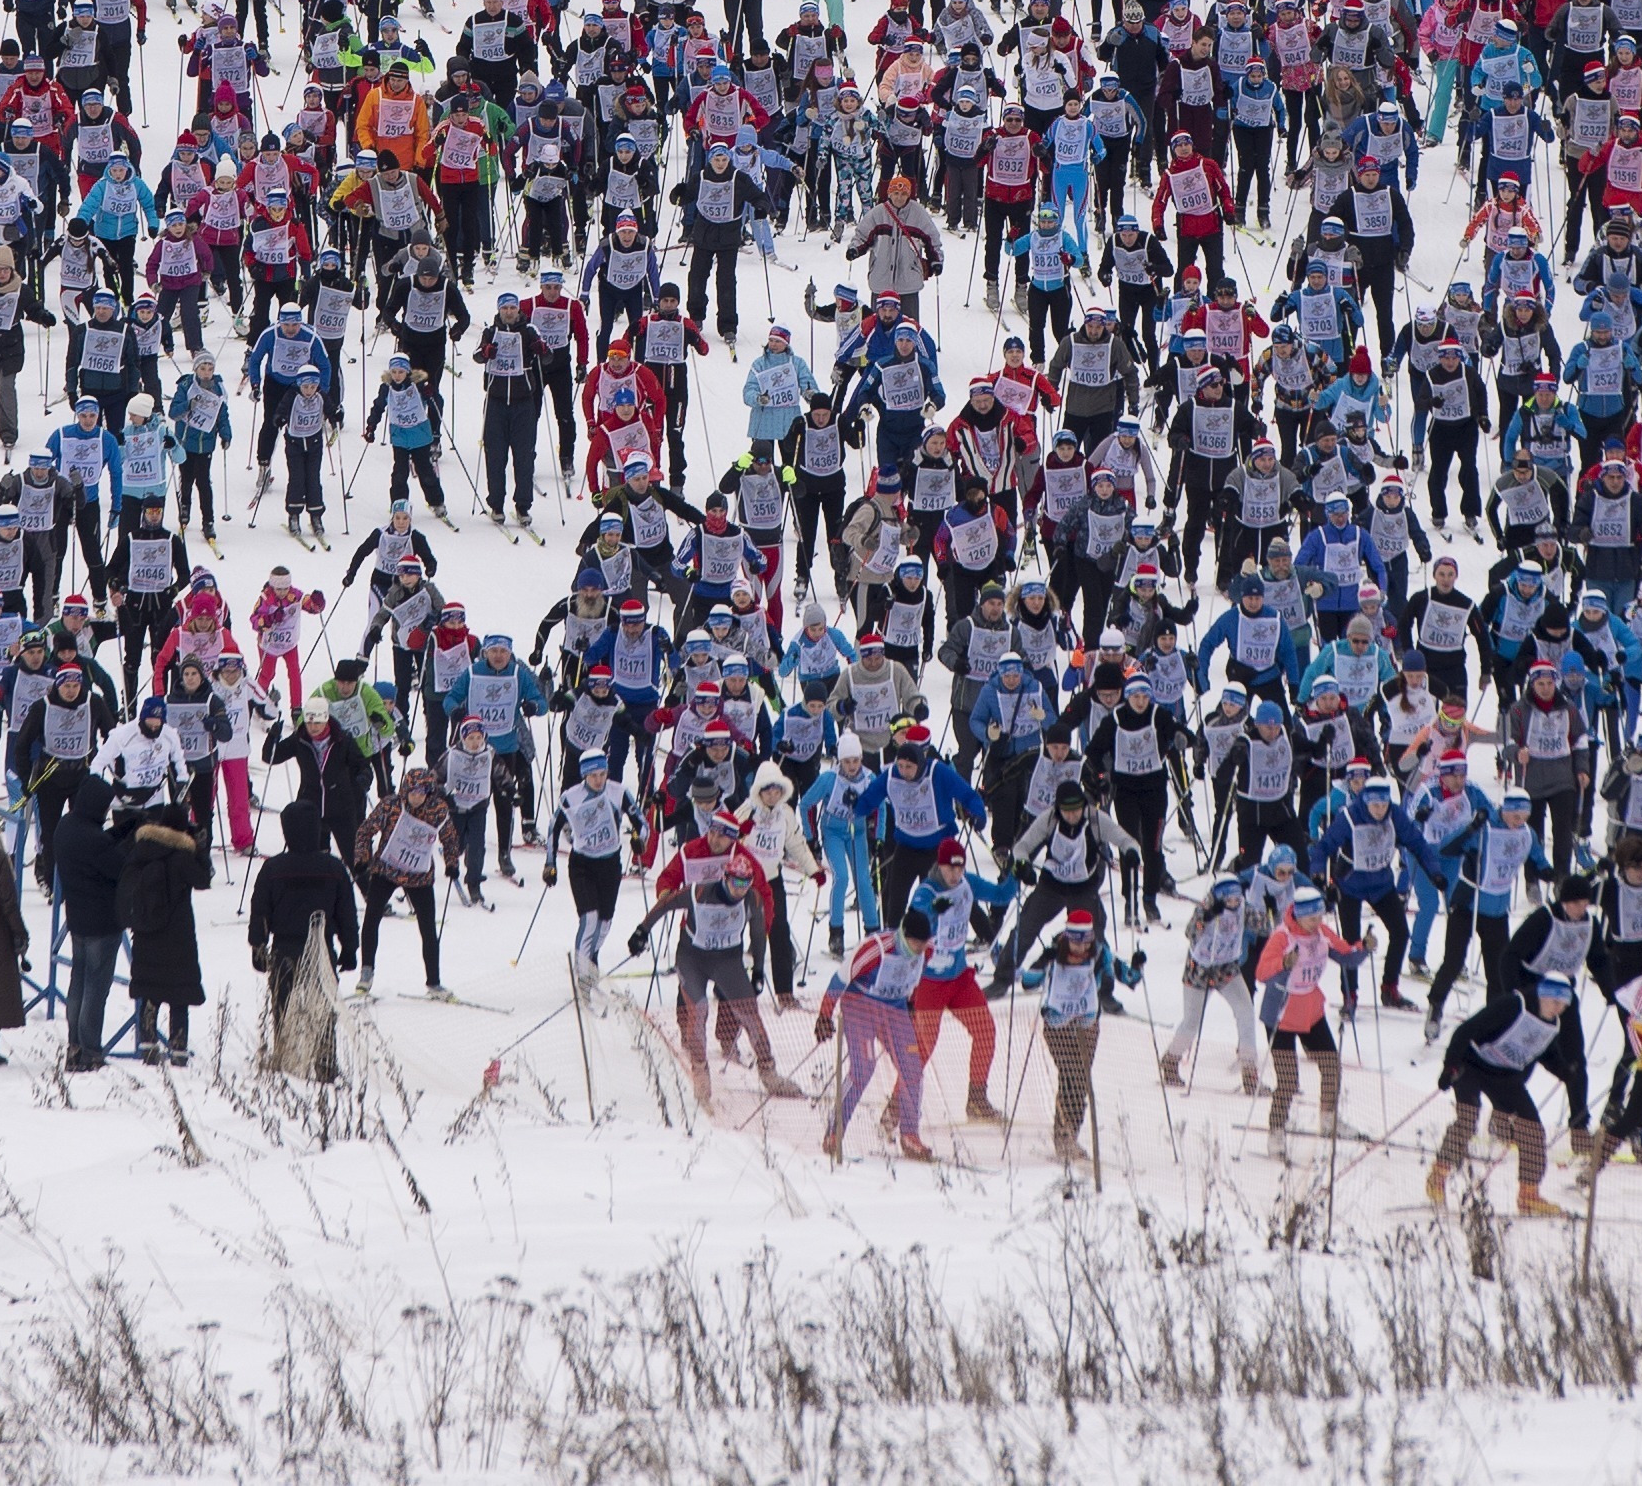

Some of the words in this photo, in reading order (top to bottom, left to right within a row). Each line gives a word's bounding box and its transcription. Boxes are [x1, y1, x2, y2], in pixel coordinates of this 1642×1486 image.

[1571, 34, 1594, 44] 14123
[1036, 85, 1056, 95] 6120
[1616, 89, 1636, 98] 3581
[1580, 125, 1606, 136] 12322
[1501, 140, 1522, 151] 3642
[997, 160, 1022, 172] 6932
[1613, 171, 1636, 182] 11516
[1182, 196, 1206, 207] 6909
[388, 216, 412, 226] 3678
[1035, 255, 1057, 266] 9820
[168, 265, 191, 275] 4005
[320, 316, 345, 327] 6630
[1308, 320, 1330, 332] 3703
[1212, 336, 1237, 347] 13407
[89, 358, 114, 371] 11666
[1075, 371, 1103, 383] 14092
[1594, 373, 1617, 385] 2522
[892, 390, 919, 405] 12980
[1197, 435, 1223, 448] 14366
[130, 461, 152, 473] 1241
[811, 456, 836, 467] 14365
[921, 497, 945, 509] 9417
[21, 516, 45, 527] 8231
[1598, 524, 1621, 536] 3652
[968, 545, 990, 558] 1267
[136, 569, 165, 579] 11646
[620, 659, 645, 672] 13171
[479, 709, 505, 722] 1424
[54, 737, 81, 749] 3537
[1126, 760, 1151, 772] 1244
[399, 849, 420, 867] 1111
